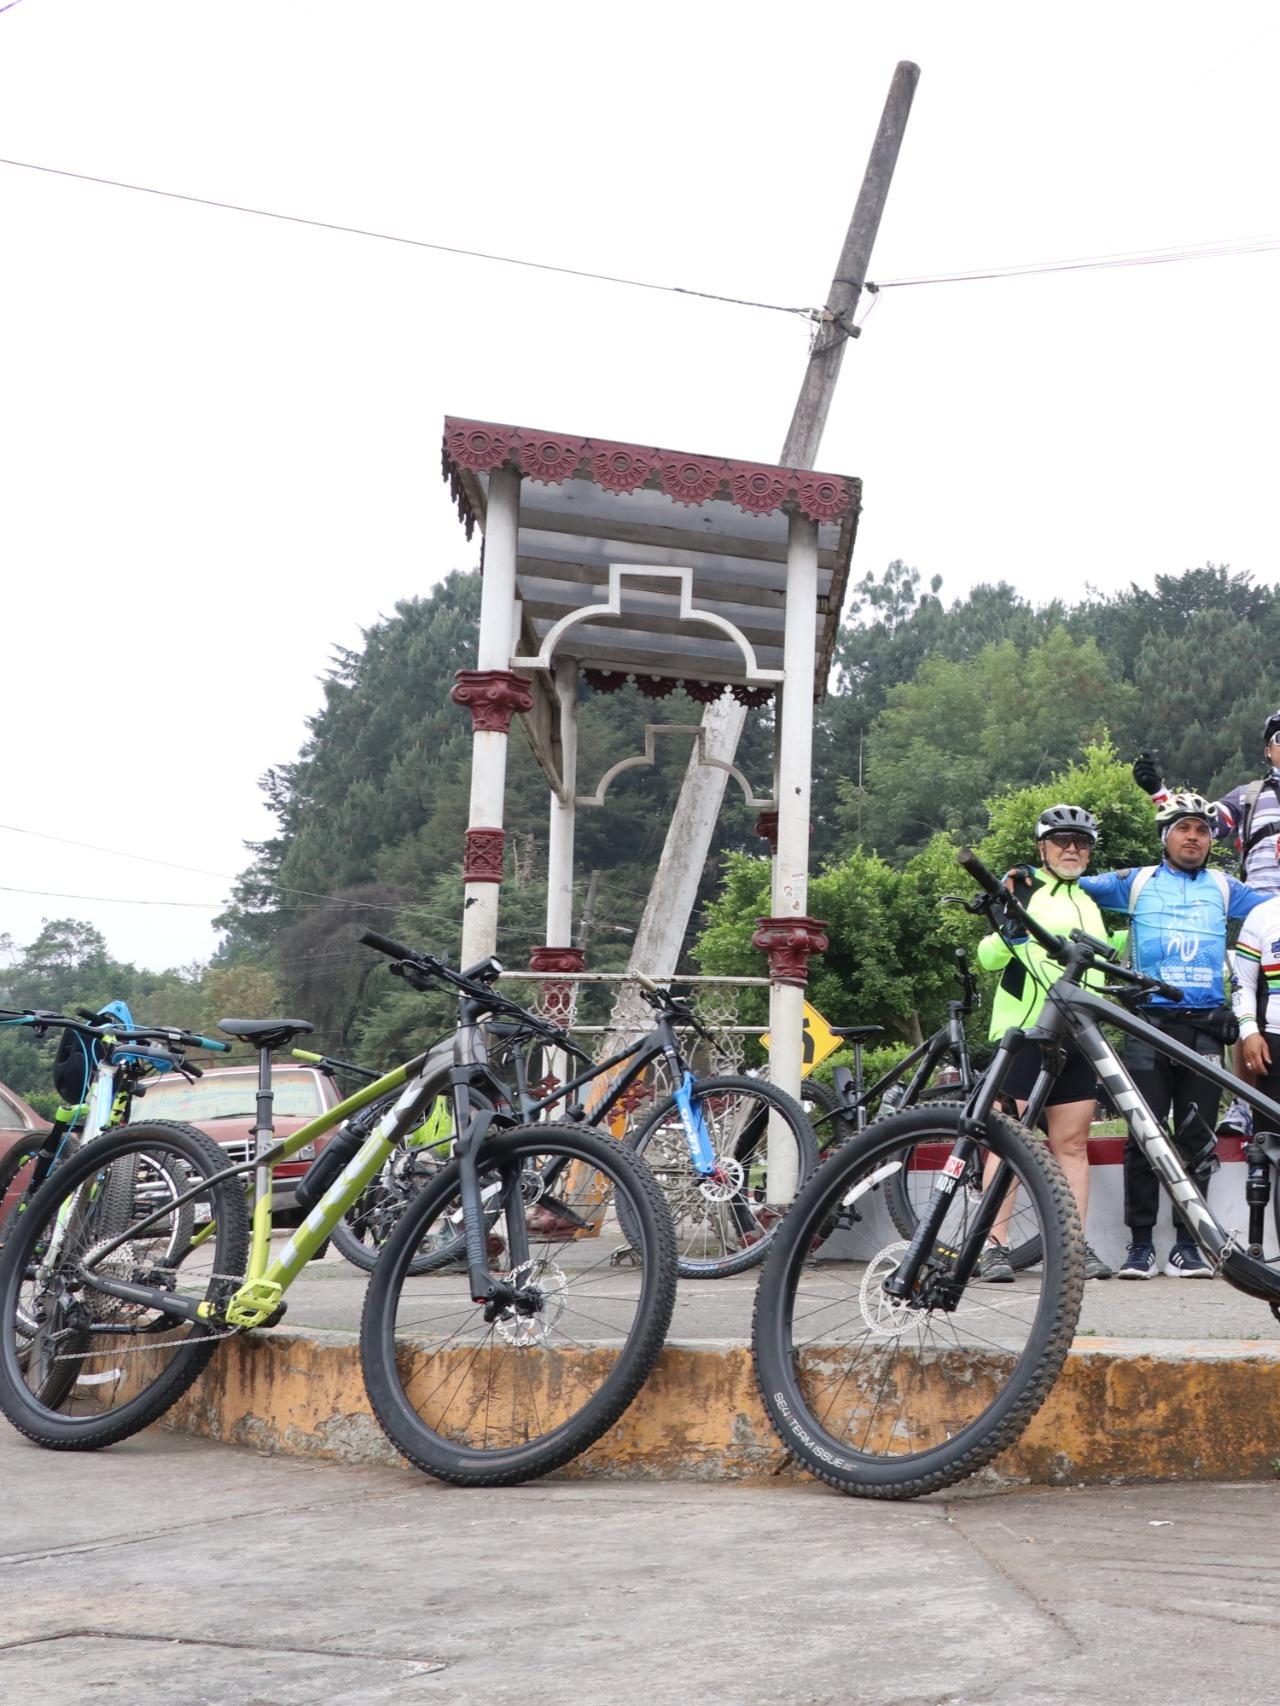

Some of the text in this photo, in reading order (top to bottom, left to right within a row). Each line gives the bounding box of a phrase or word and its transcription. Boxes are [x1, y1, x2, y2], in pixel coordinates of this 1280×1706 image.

[1094, 1041, 1218, 1230] TREK
[464, 1206, 483, 1265] ROCKSHOX
[774, 1392, 846, 1468] SE4 TEAM ISSUE
